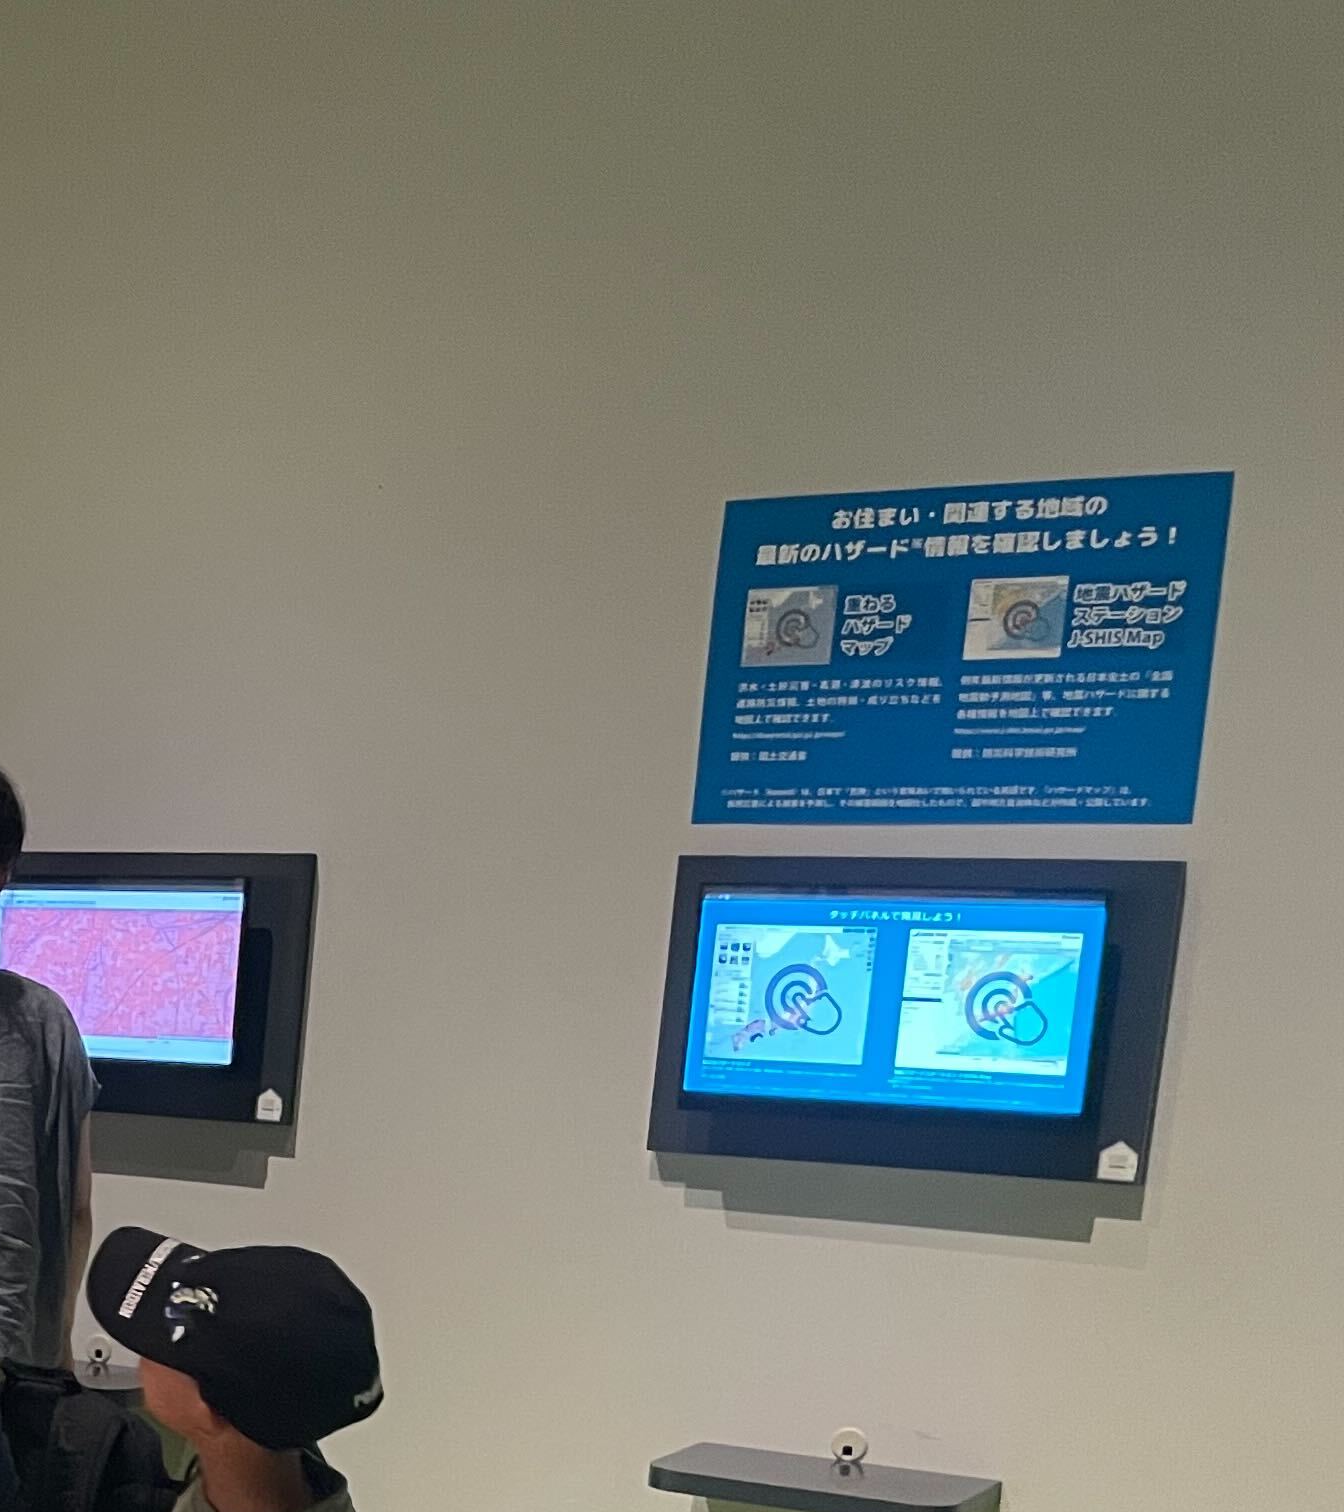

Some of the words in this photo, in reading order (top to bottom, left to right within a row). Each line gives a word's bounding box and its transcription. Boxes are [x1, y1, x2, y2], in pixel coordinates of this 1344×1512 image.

[1073, 580, 1187, 604] 地震ハザード
[841, 614, 912, 636] ハザード
[1071, 605, 1184, 626] ステーション
[840, 636, 894, 656] マップ
[1123, 628, 1165, 649] Map
